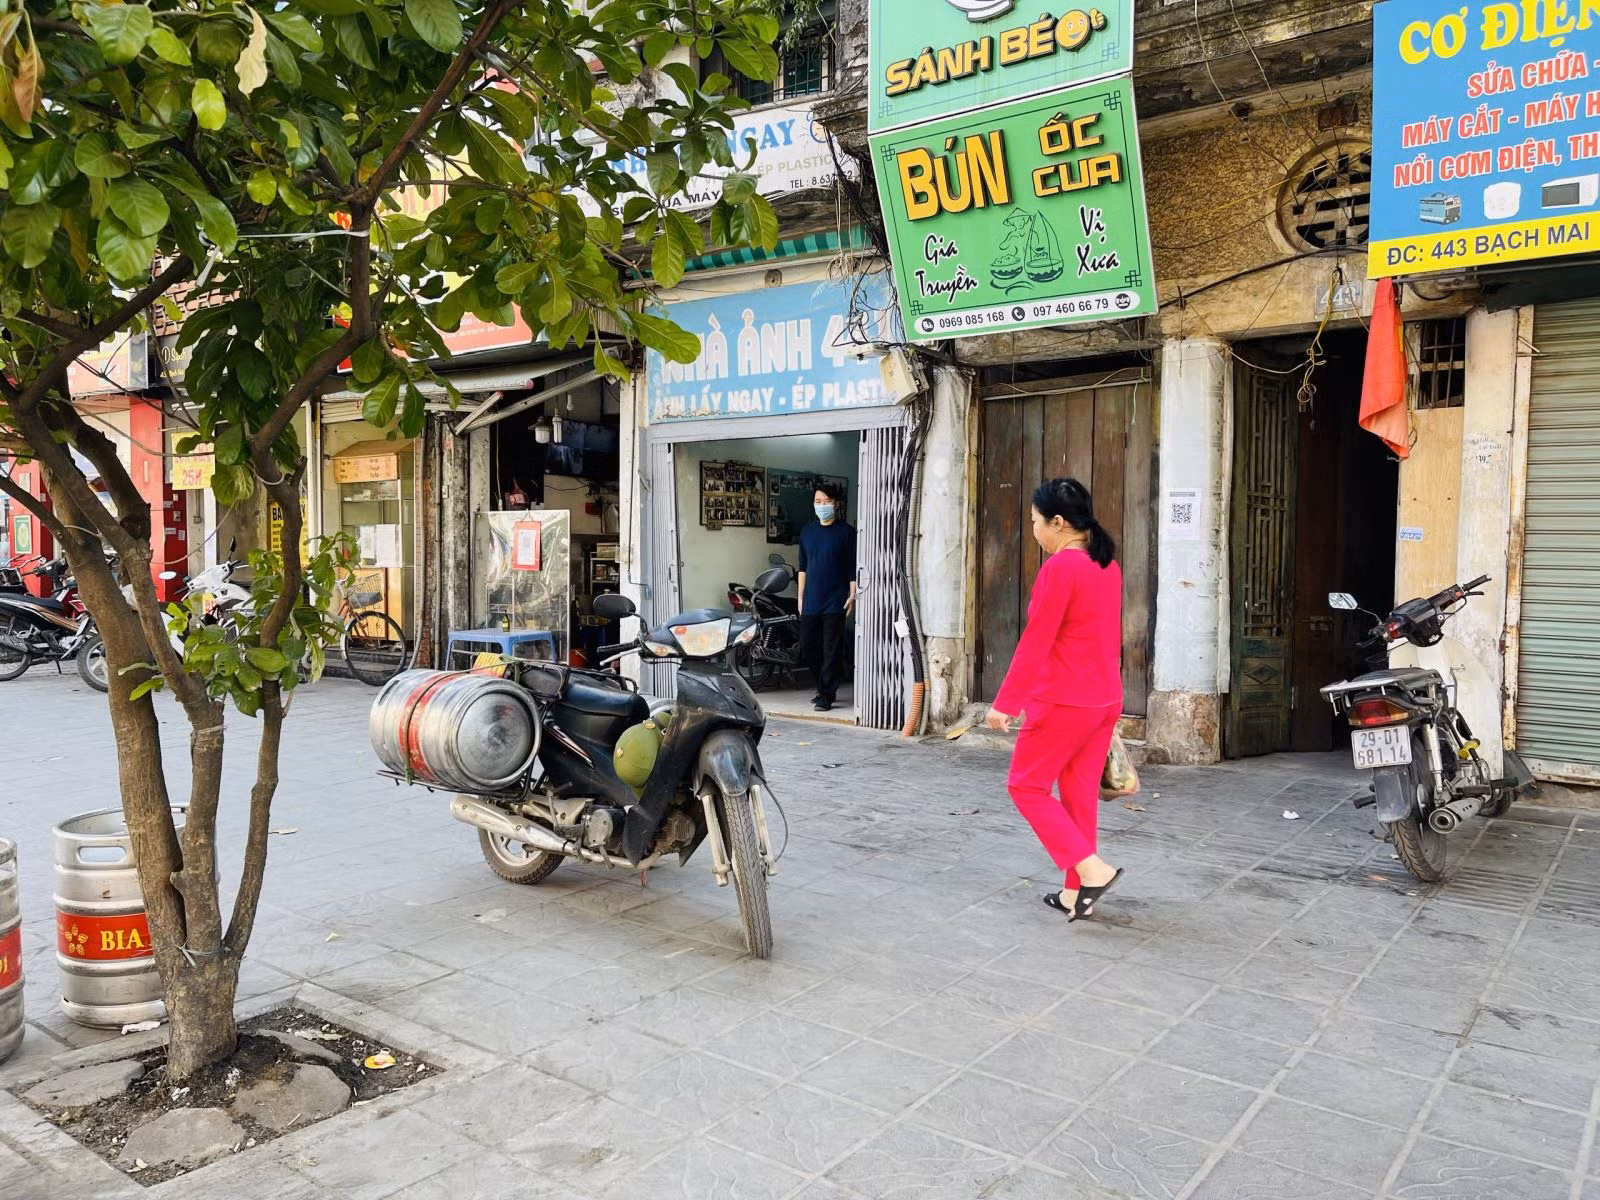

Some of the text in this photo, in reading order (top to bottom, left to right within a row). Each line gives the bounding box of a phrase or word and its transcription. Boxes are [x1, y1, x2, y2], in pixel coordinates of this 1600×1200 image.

[1399, 6, 1468, 64] CƠ
[885, 35, 994, 97] SÁNH
[1467, 60, 1515, 98] SỬA
[1521, 49, 1588, 89] CHỮA
[1038, 111, 1104, 157] ỐC
[1402, 114, 1452, 148] MÁY
[1458, 103, 1503, 139] CẮT
[1525, 93, 1581, 128] MÁY
[778, 154, 833, 173] PLASTIC
[896, 128, 1013, 222] BÚN
[1031, 152, 1123, 197] CUA
[1394, 132, 1600, 188] NỒI CƠM ĐIỆN, TH
[688, 188, 721, 204] MÁY
[790, 179, 804, 189] TEL
[1079, 204, 1106, 244] Vị
[1387, 222, 1590, 266] ĐC: 443 BẠCH MAI
[924, 234, 958, 266] Gia
[1076, 244, 1120, 276] Xưa
[915, 265, 978, 304] Truyền
[939, 298, 1109, 329] 0969 085 168 097 460 66 79
[737, 308, 812, 377] ẢNH
[727, 387, 775, 413] NGAY
[791, 376, 816, 409] ÉP
[822, 378, 885, 408] PLAST
[101, 928, 145, 951] BIA
